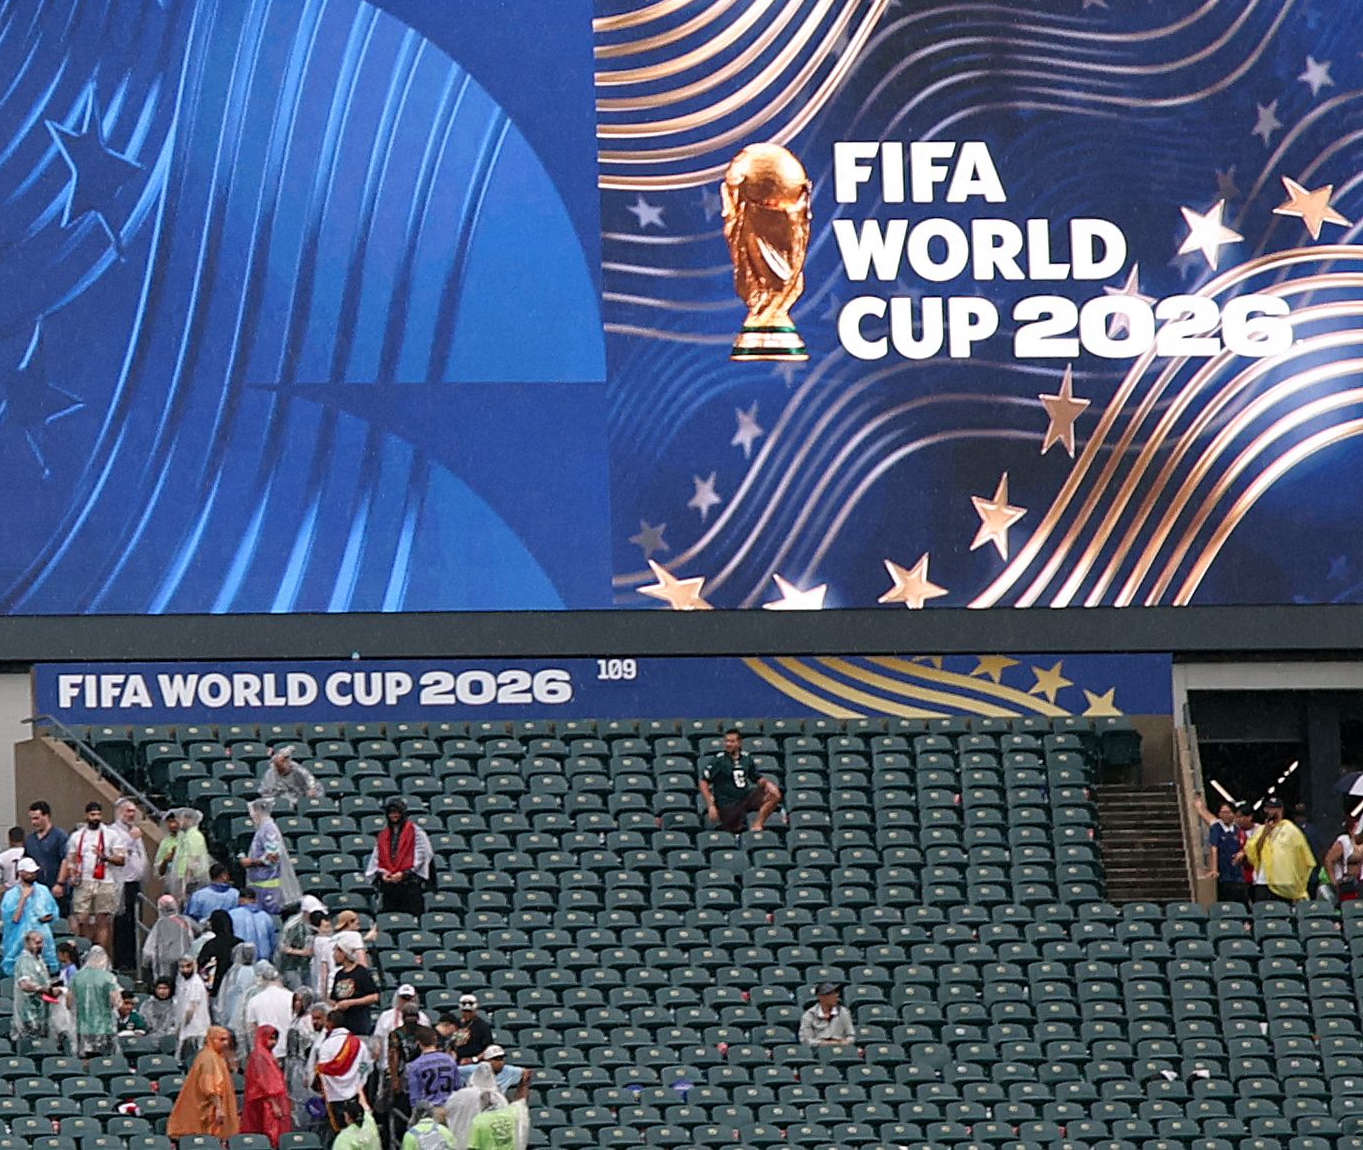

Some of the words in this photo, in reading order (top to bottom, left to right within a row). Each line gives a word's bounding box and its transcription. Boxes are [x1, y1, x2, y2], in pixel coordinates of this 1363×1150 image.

[834, 142, 1007, 203] FIFA
[832, 217, 1127, 282] WORLD
[838, 295, 999, 359] CUP
[1014, 295, 1293, 357] 2026
[59, 674, 153, 708] FIFA
[156, 673, 318, 708] WORLD
[324, 672, 413, 707] CUP
[418, 669, 573, 706] 2026
[596, 659, 637, 680] 109
[421, 1066, 453, 1095] 25
